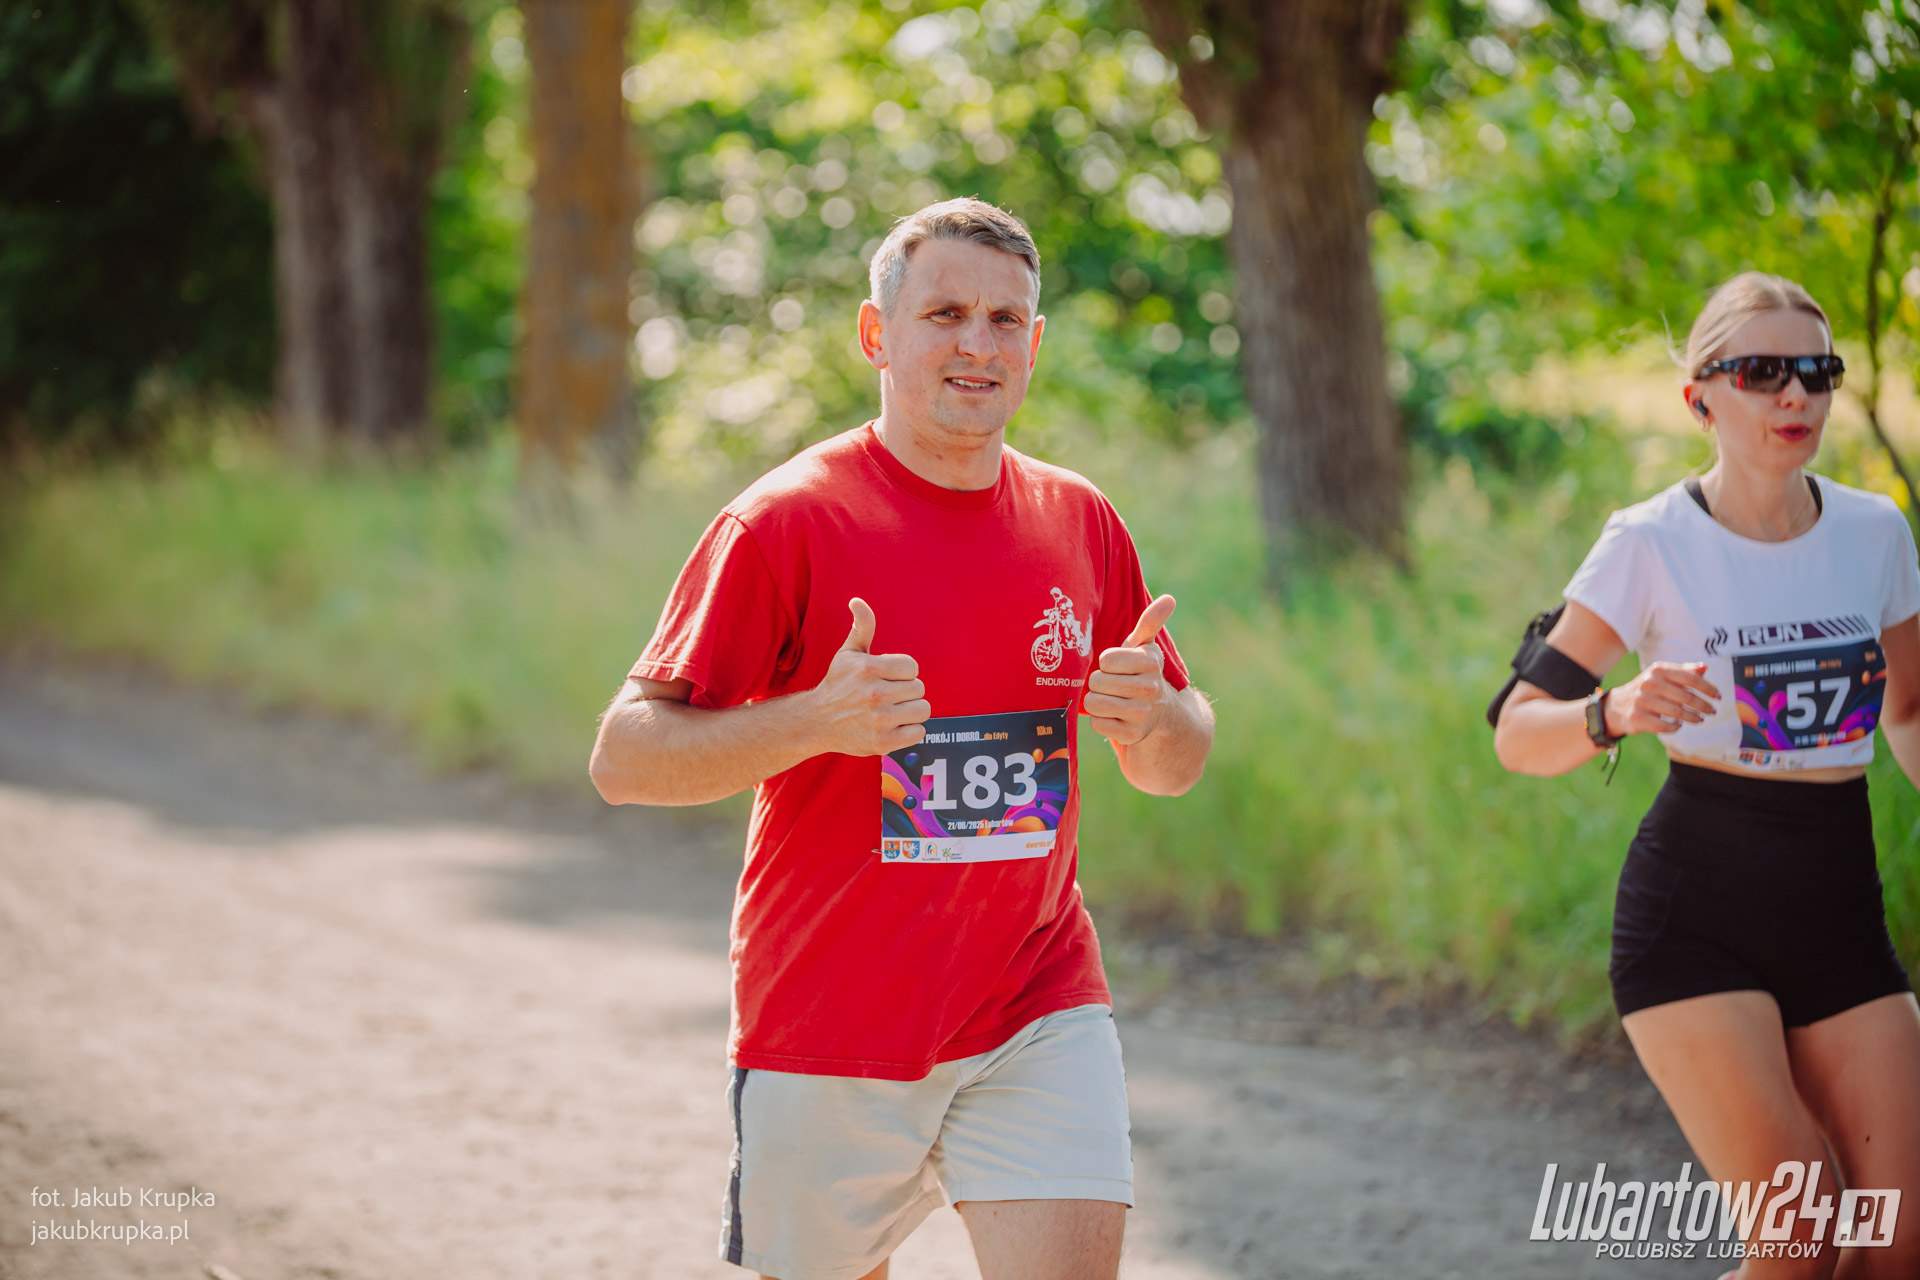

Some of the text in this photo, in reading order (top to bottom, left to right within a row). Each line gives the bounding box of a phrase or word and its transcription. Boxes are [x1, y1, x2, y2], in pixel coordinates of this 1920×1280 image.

[1743, 624, 1803, 646] RUN
[1036, 677, 1070, 687] ENDURO
[1786, 676, 1851, 730] 57
[925, 732, 951, 744] POKÓJ
[922, 752, 1038, 810] 183
